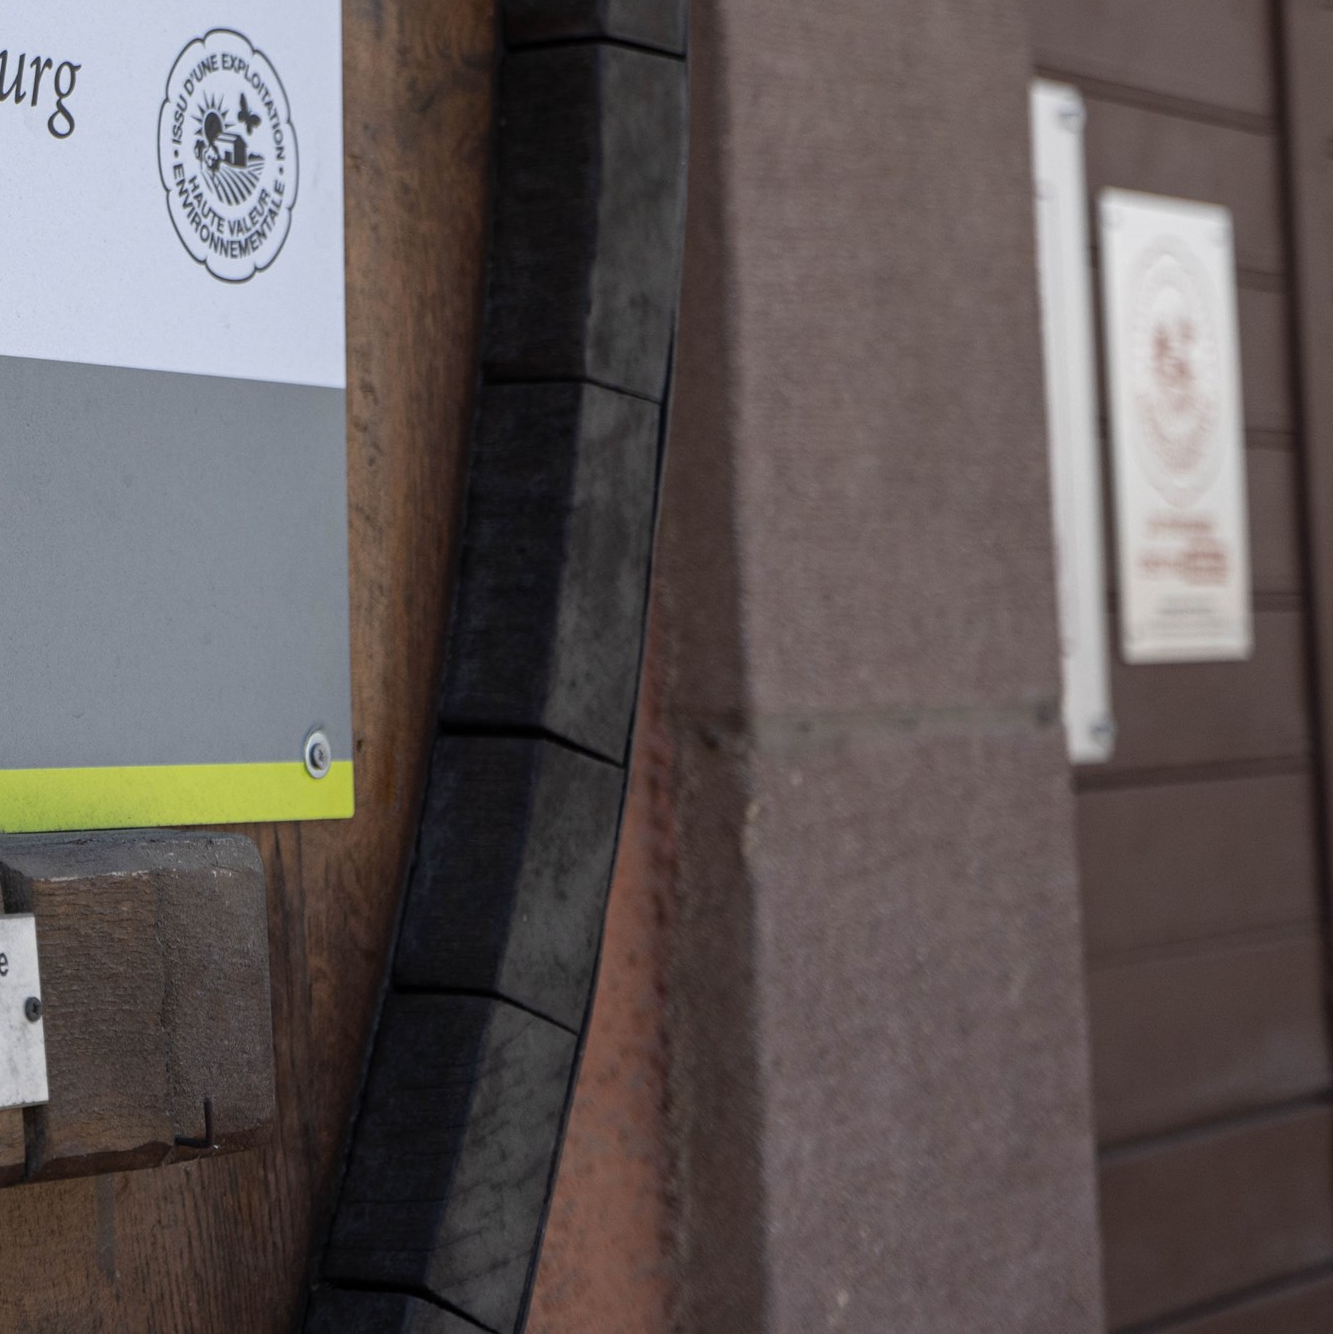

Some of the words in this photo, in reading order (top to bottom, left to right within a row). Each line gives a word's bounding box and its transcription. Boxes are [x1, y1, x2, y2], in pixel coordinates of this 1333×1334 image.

[171, 94, 188, 146] ISSU
[183, 53, 220, 98] D'UNE
[221, 53, 286, 162] EXPLOITATION
[172, 162, 287, 260] ENVIRONNEMENTALE
[187, 174, 225, 235] HAUTE
[227, 187, 272, 239] VALEUR
